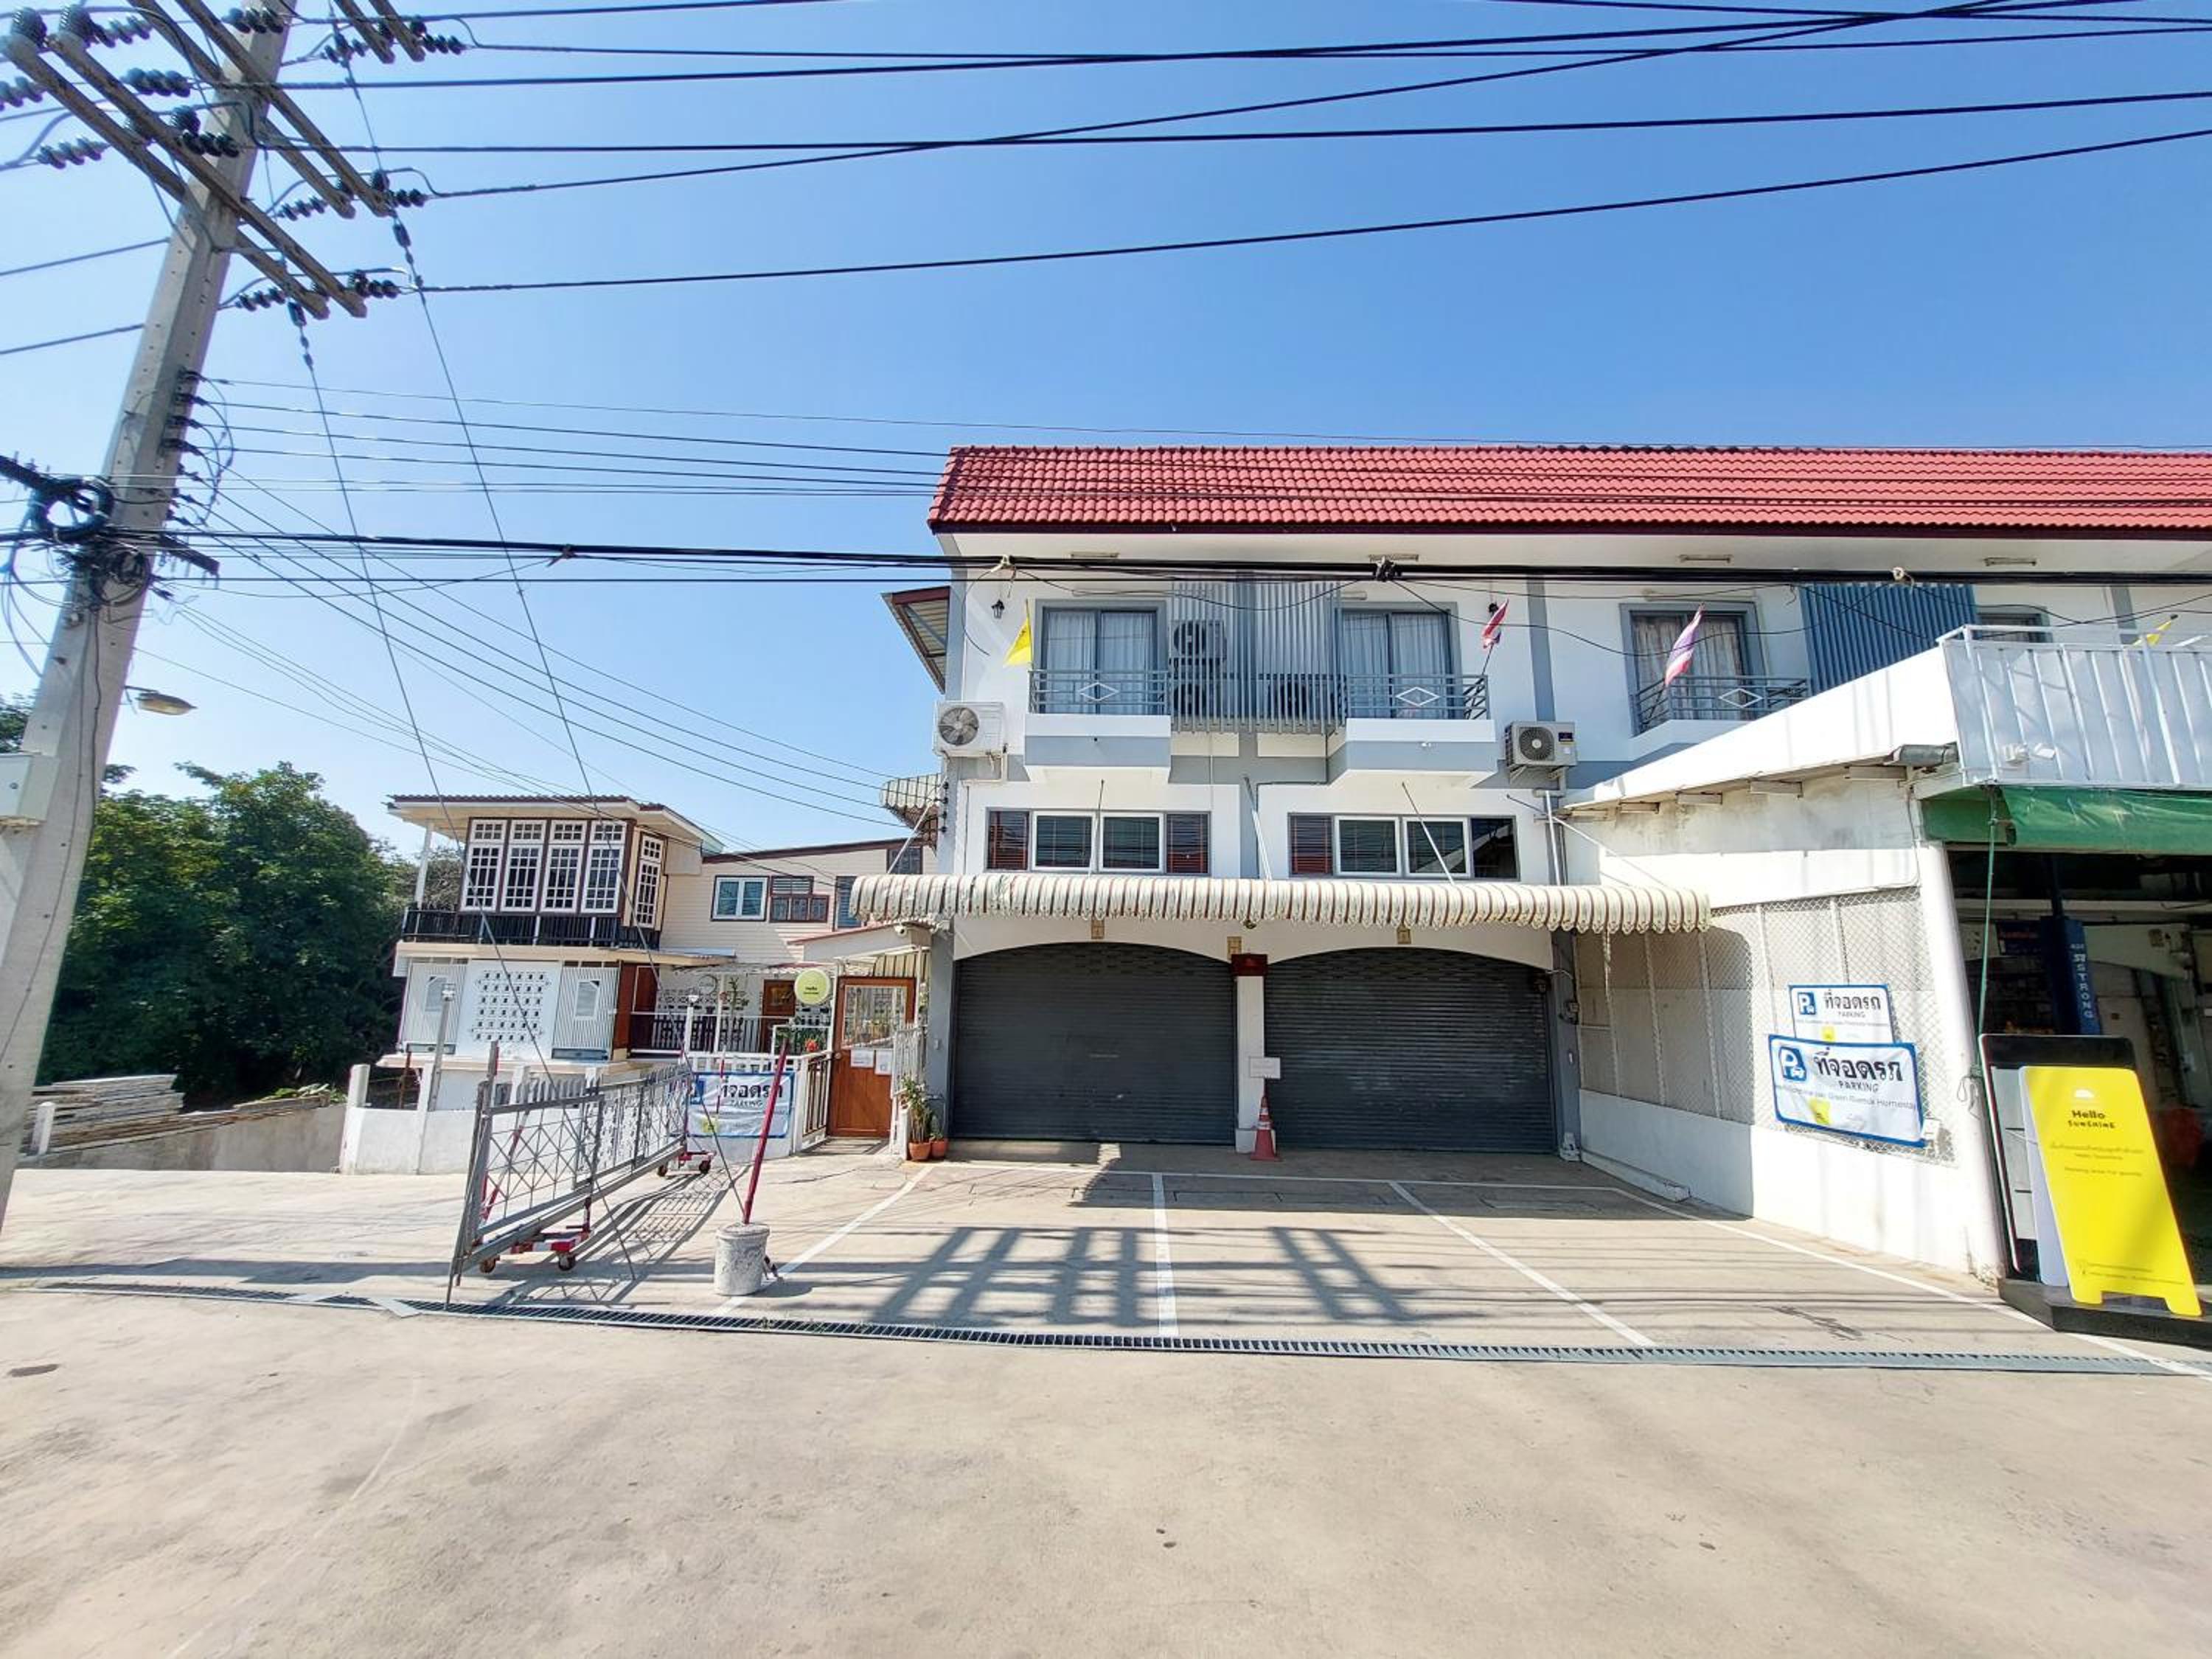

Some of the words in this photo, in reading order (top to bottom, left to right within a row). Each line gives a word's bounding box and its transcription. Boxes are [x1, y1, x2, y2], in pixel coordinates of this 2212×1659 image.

[1823, 989, 1881, 1010] ที่จอดรถ
[1813, 1046, 1904, 1082] ที่จอดรถ
[1838, 1080, 1879, 1093] PARKING
[2072, 1110, 2106, 1119] Hello
